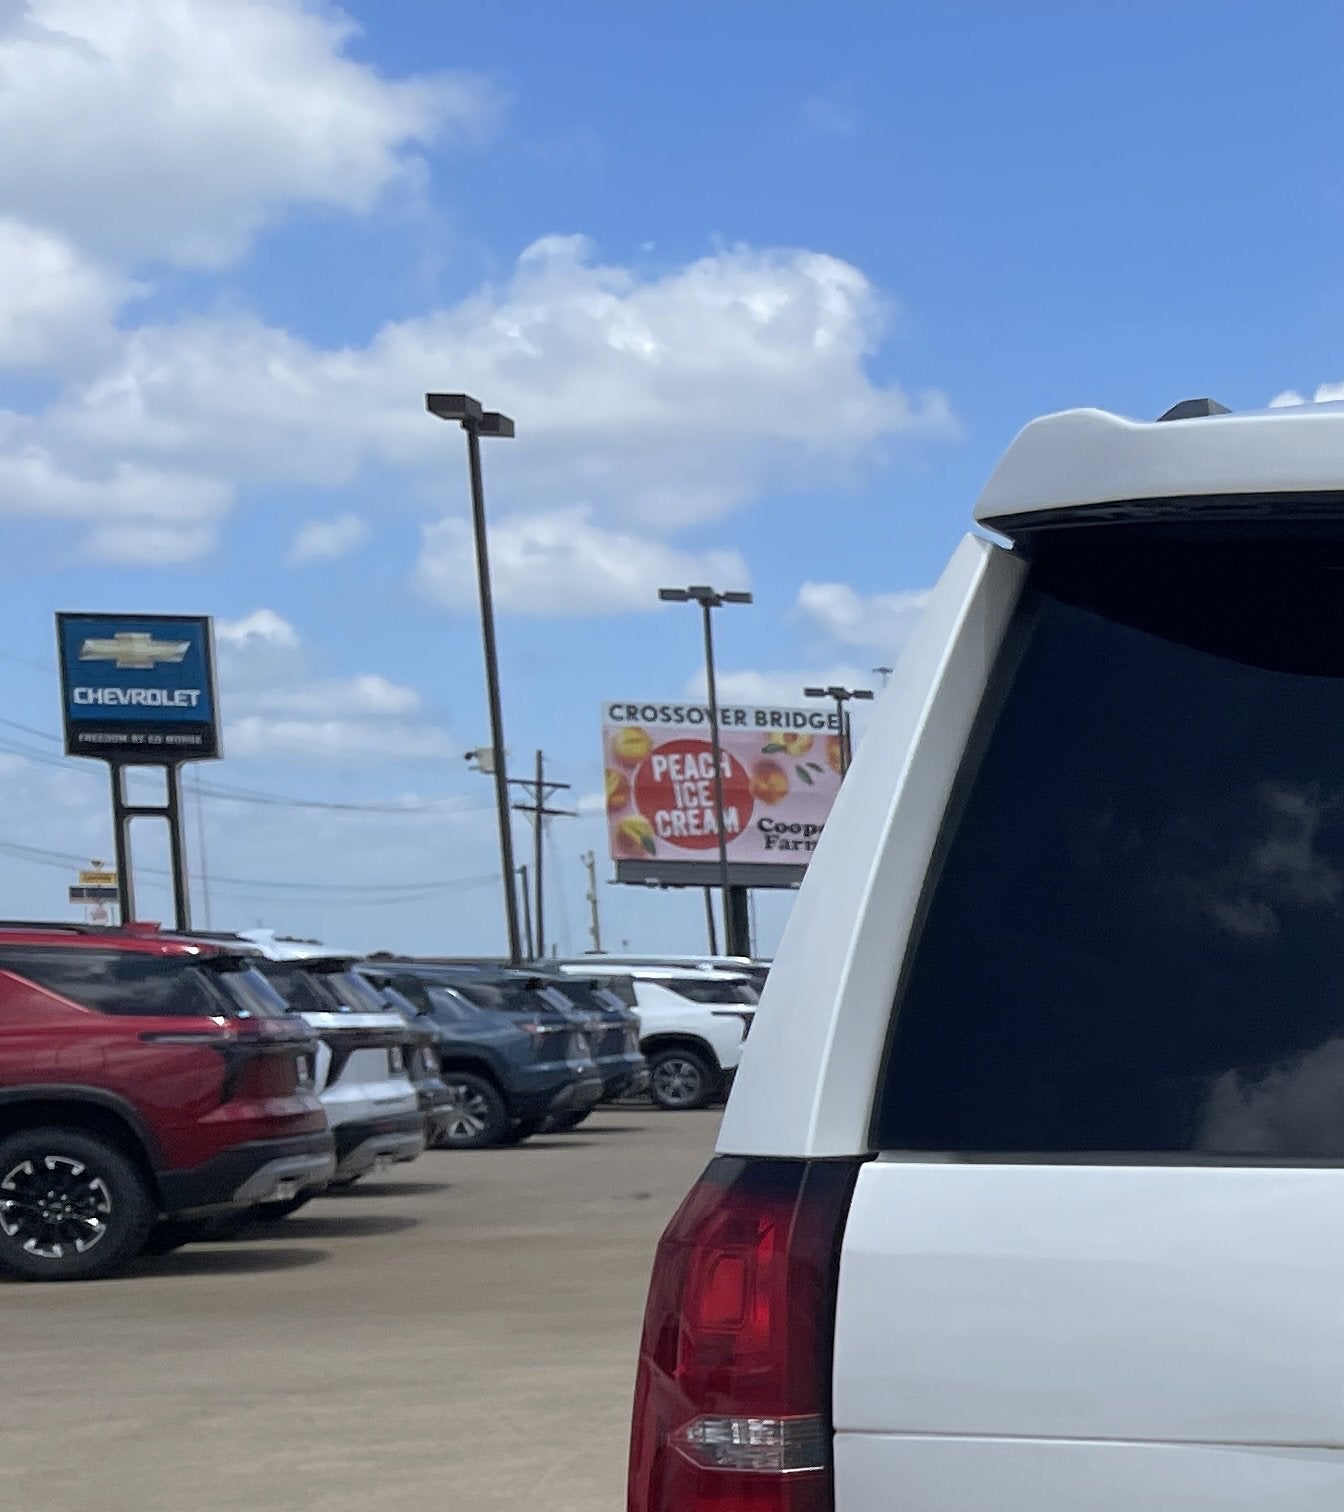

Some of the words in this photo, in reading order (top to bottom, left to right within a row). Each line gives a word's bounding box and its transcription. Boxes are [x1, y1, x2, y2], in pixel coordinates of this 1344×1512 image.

[73, 687, 201, 707] CHEVROLET
[608, 704, 747, 727] CROSSOVER
[754, 710, 841, 731] BRIDGE
[651, 751, 733, 783] PEACH
[672, 780, 715, 809] ICE
[654, 806, 740, 838] CREAM
